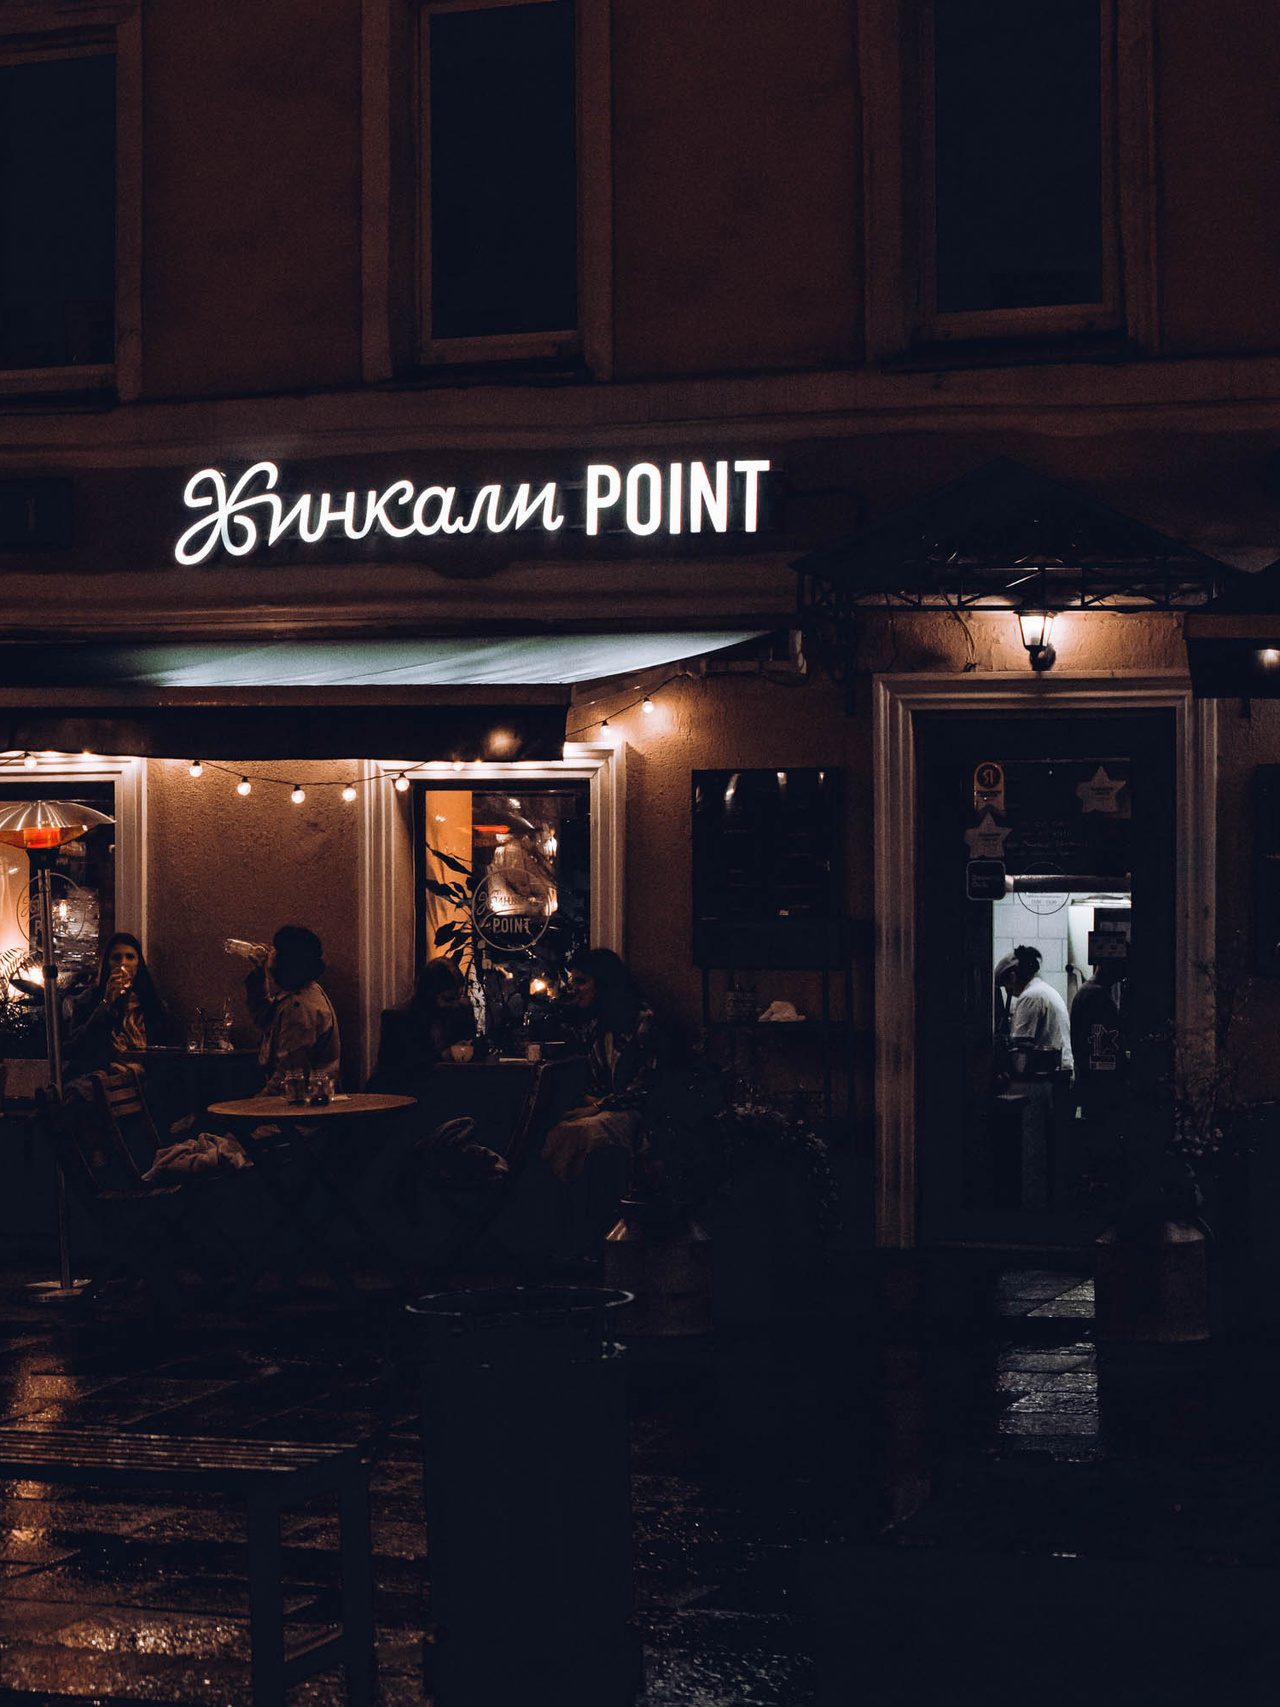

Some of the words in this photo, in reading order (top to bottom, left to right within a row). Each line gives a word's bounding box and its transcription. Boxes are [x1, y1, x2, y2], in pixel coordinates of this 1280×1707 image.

[173, 460, 566, 566] Хинкали
[585, 459, 771, 537] POINT
[493, 918, 531, 933] POINT
